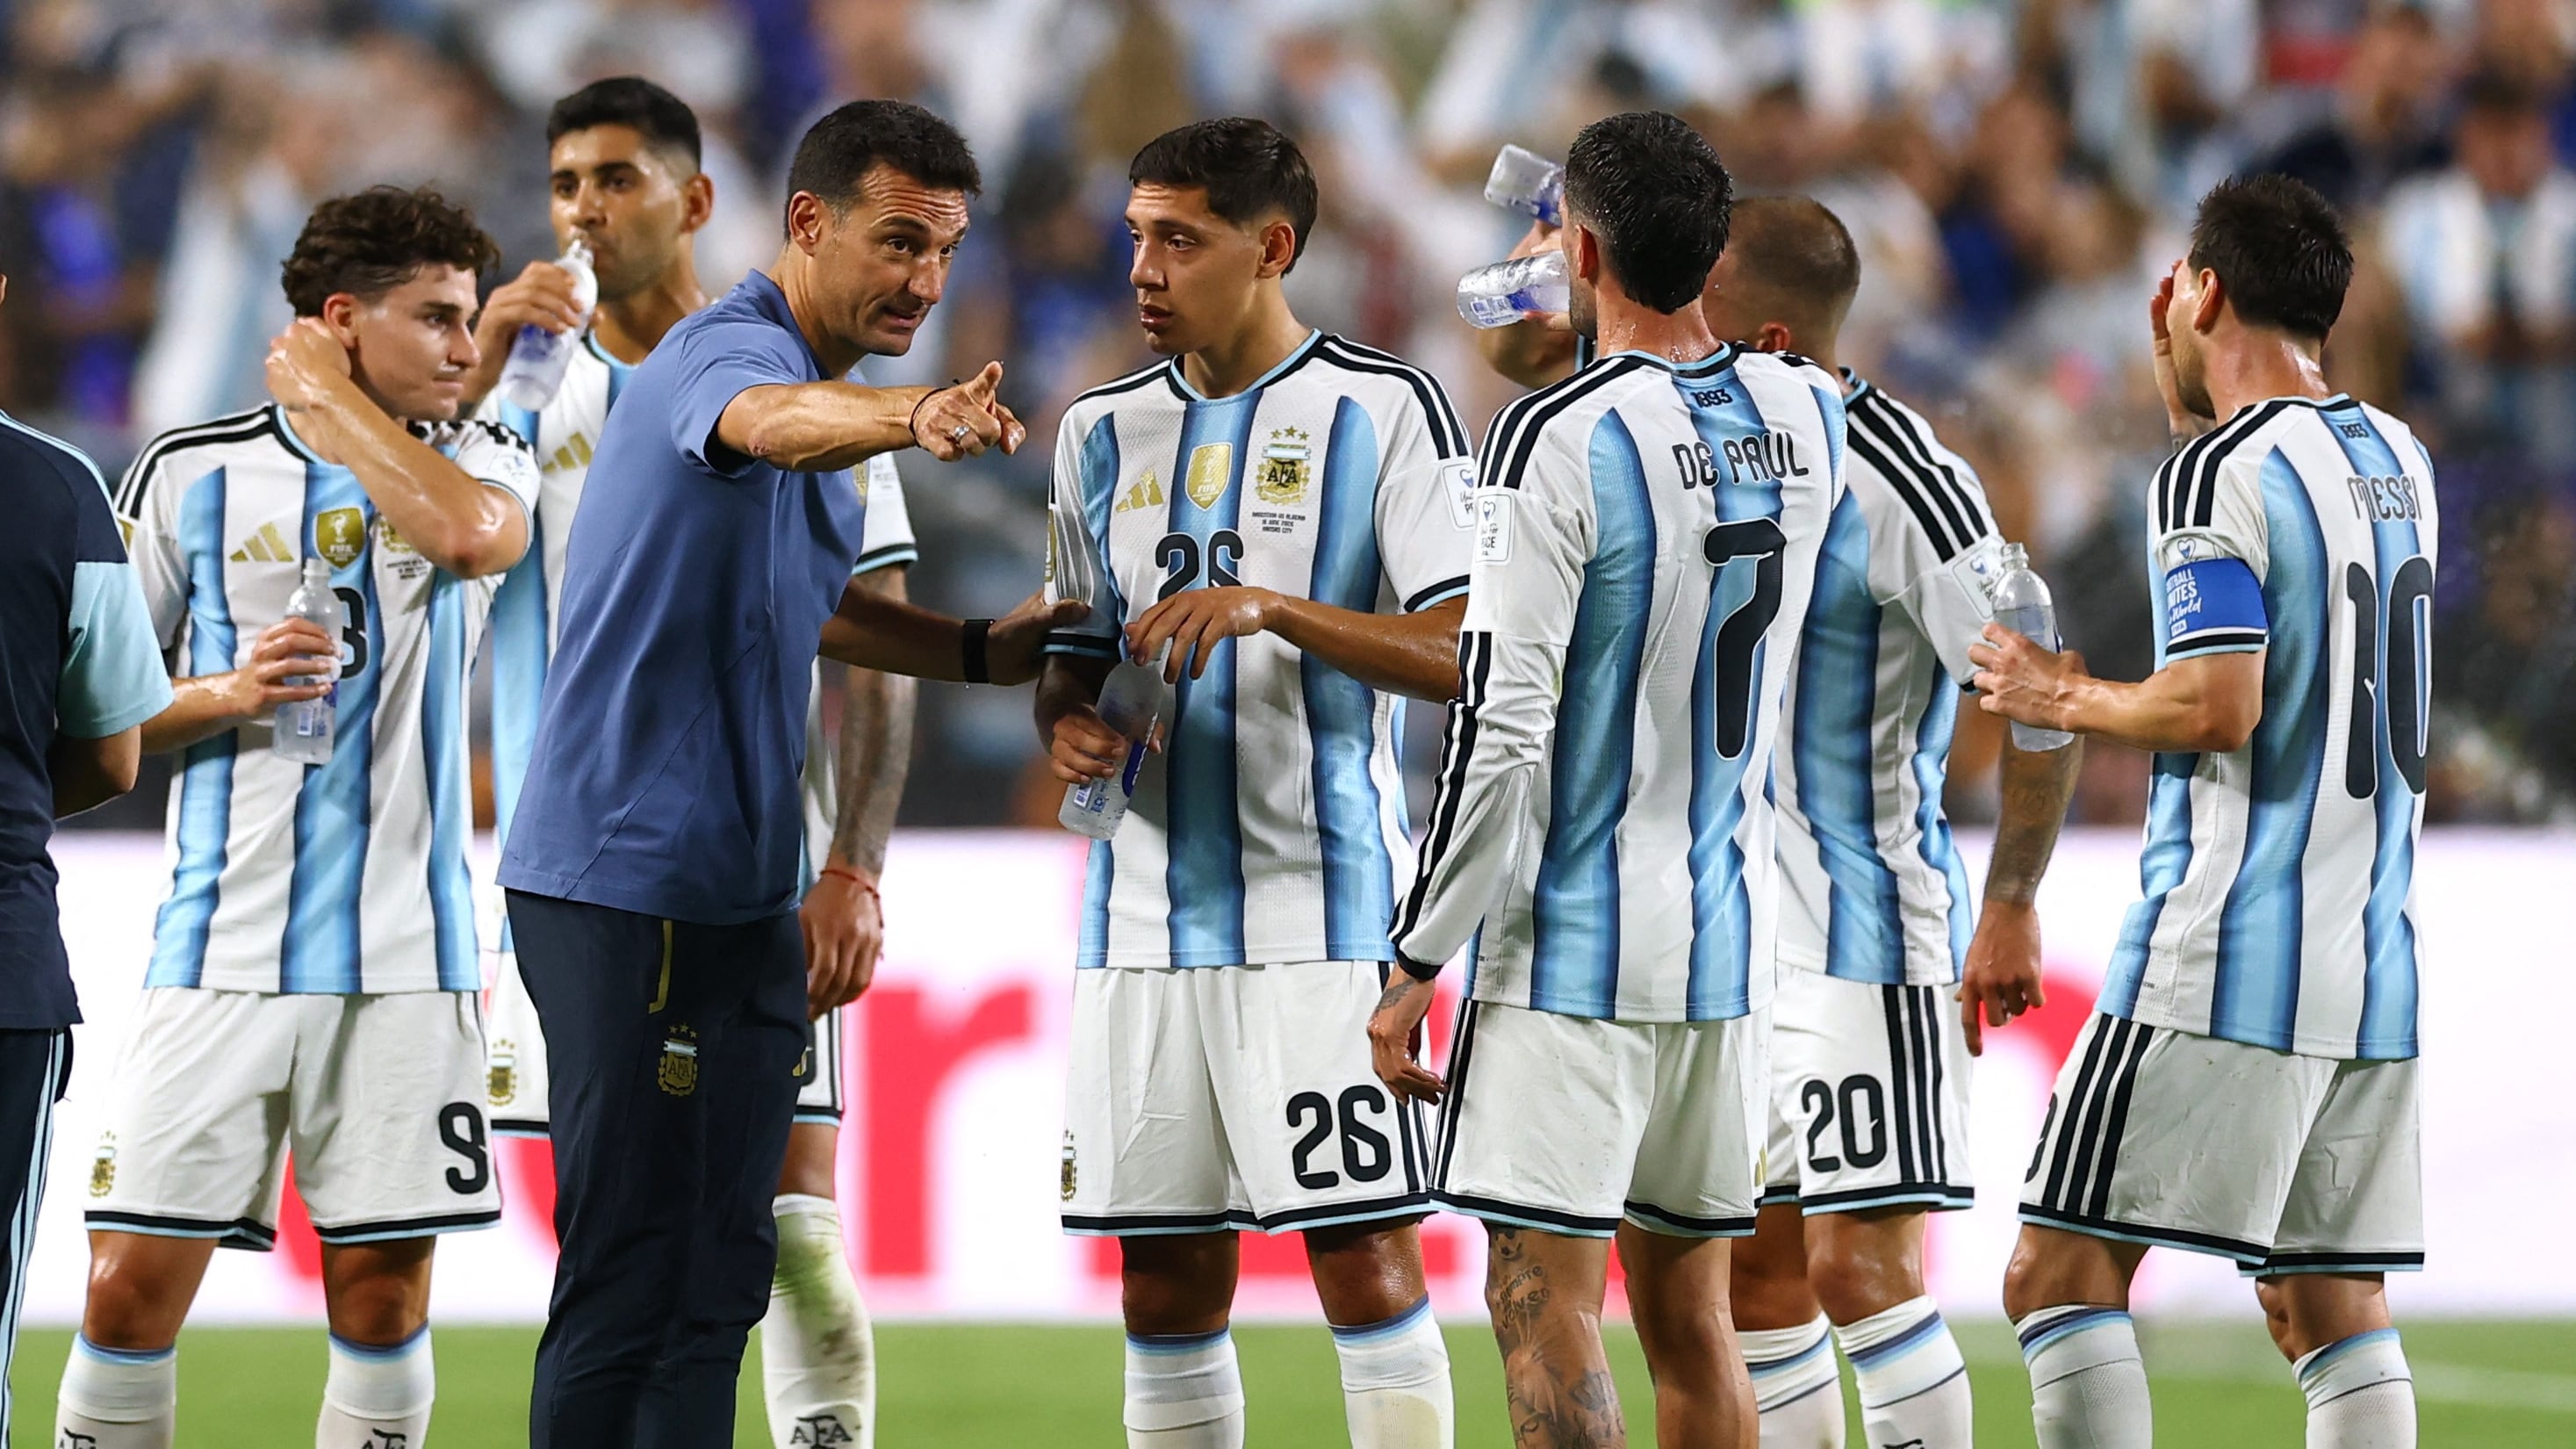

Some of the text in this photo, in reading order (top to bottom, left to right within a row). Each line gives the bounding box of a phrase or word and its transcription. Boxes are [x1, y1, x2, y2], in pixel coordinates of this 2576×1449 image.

[1691, 387, 1733, 408] 1893
[1266, 459, 1299, 488] AFA
[1672, 432, 1809, 490] DE PAUL
[2347, 475, 2421, 520] MESSI
[1155, 530, 1244, 603] 26
[1702, 516, 1787, 759] 7
[2345, 555, 2433, 800] 10
[438, 1101, 489, 1194] 9
[1286, 1085, 1392, 1189] 26
[1802, 1074, 1887, 1173] 20
[788, 1415, 853, 1449] AFA
